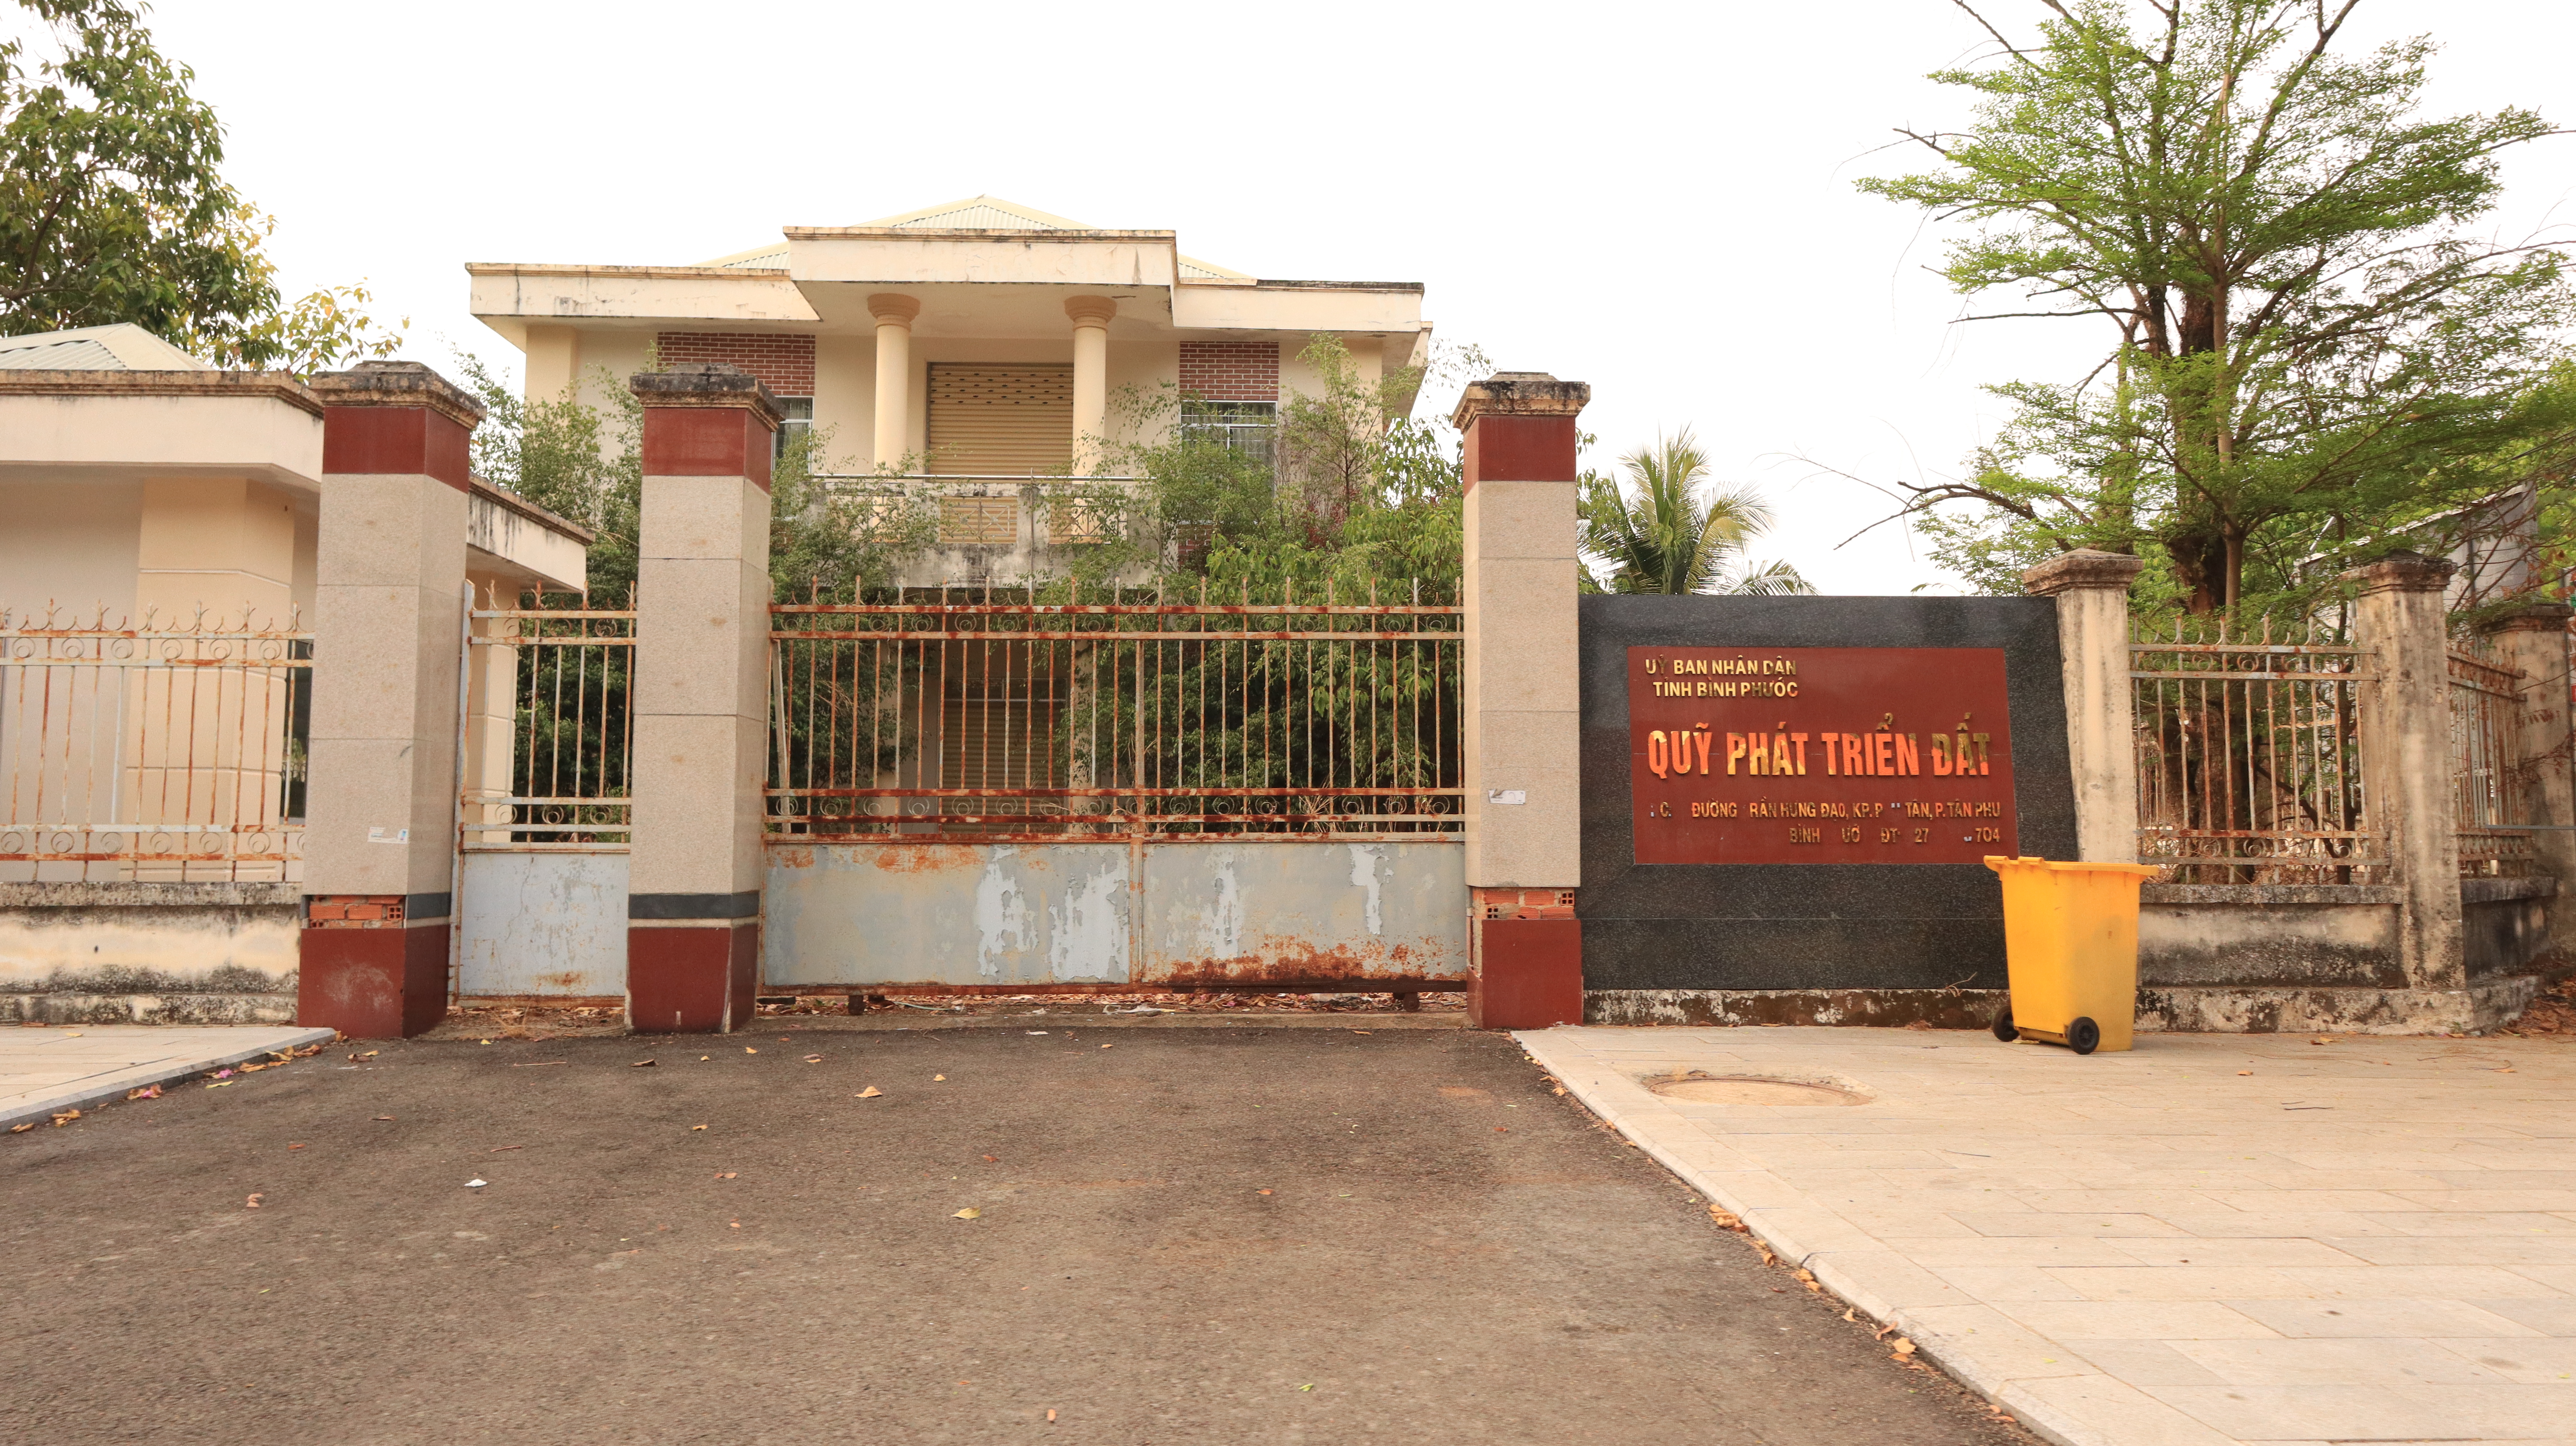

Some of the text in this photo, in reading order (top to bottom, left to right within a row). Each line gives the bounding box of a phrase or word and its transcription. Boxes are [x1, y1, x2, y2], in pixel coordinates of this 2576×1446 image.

[1674, 659, 1707, 674] BAN
[1712, 655, 1758, 674] NHÂN
[1763, 655, 1796, 675] DÂN
[1653, 677, 1798, 697] TỈNH BÌNH PHƯỚC
[1648, 712, 1991, 779] QUỸ PHÁT TRIỂN ĐẤT
[1691, 798, 1737, 817] ĐƯỜNG
[1789, 823, 1820, 843] BÌNH
[1914, 827, 1929, 843] 27
[1975, 827, 2000, 842] 704
